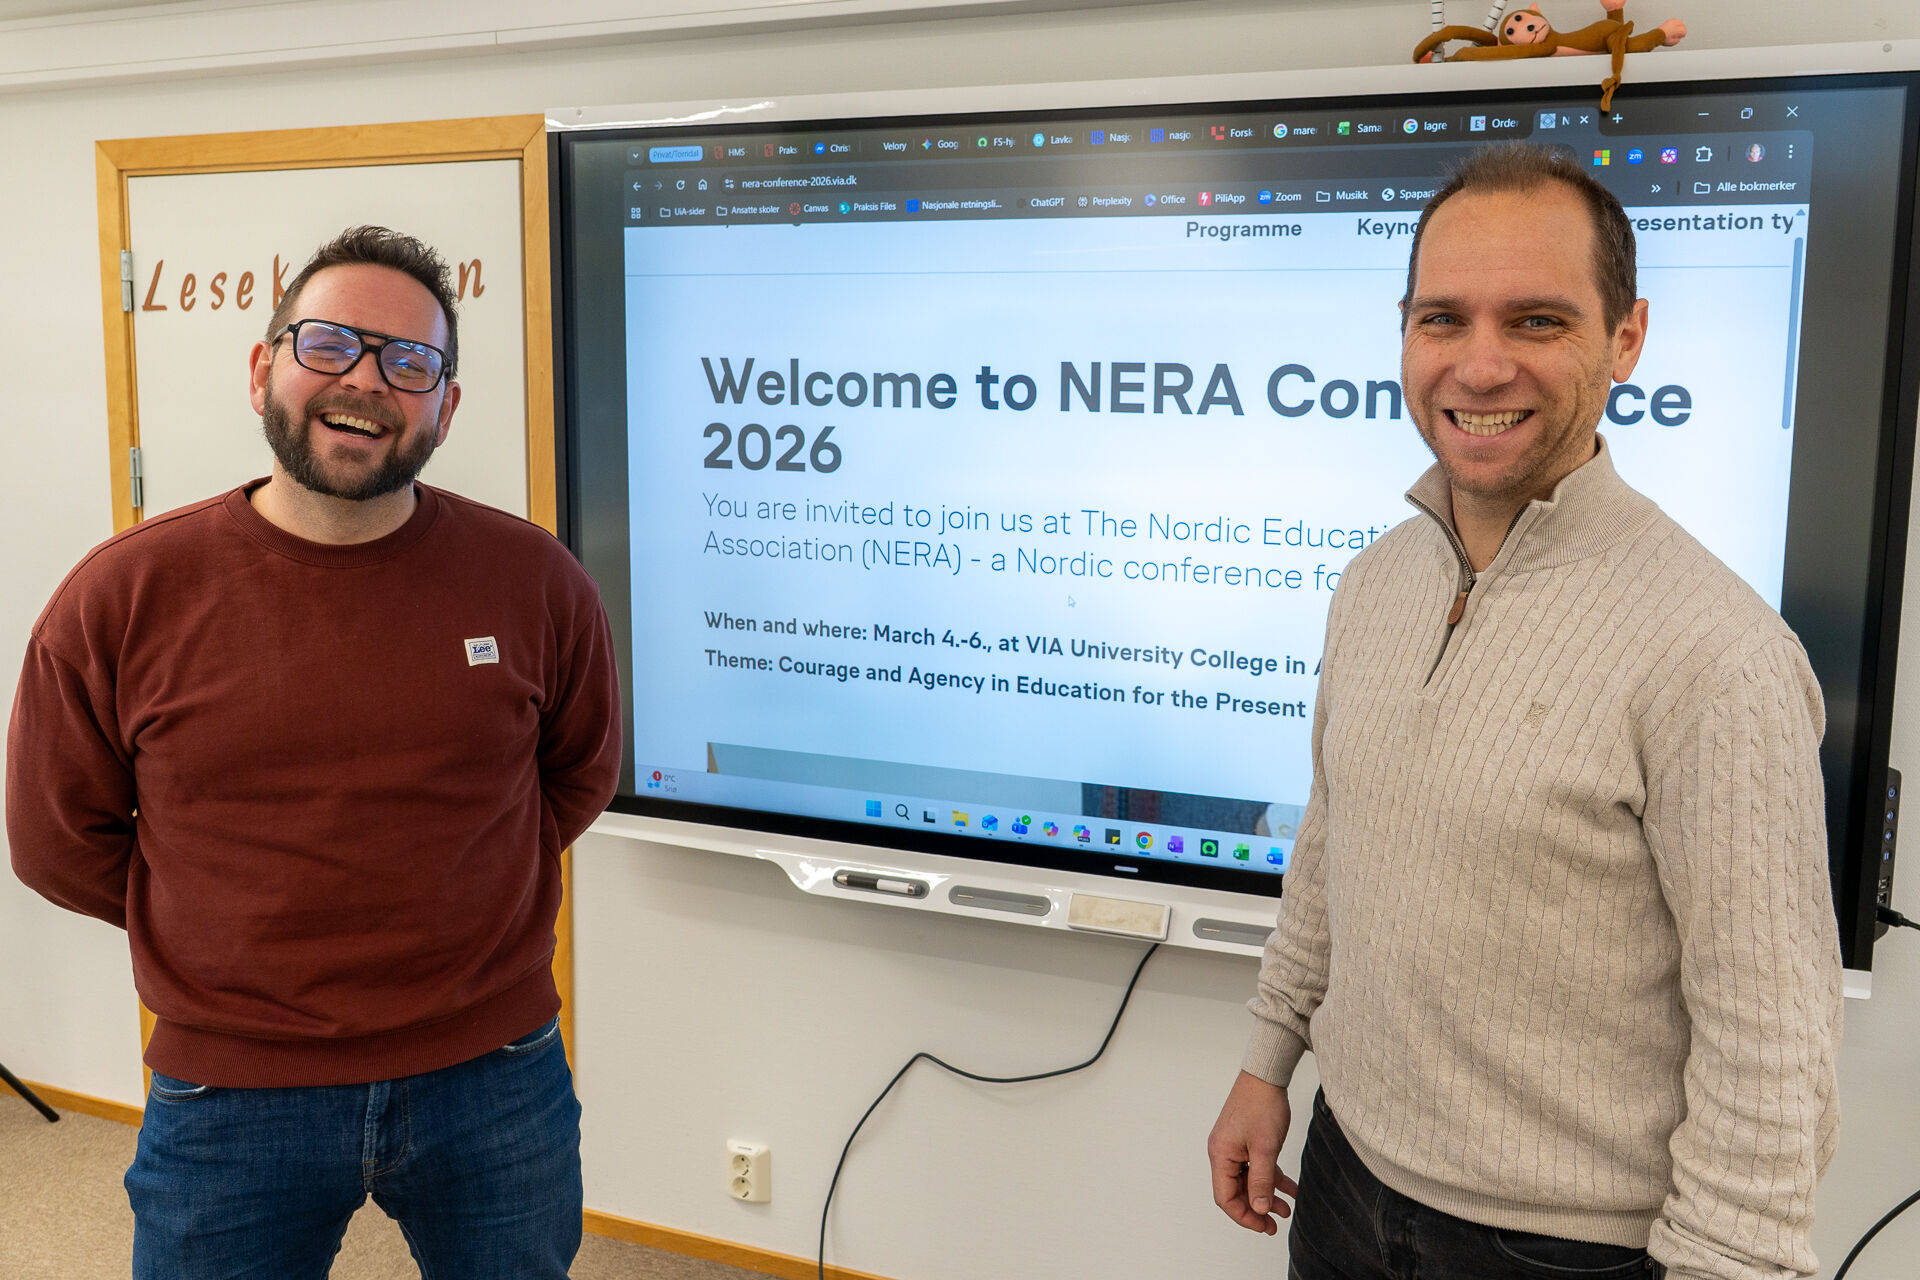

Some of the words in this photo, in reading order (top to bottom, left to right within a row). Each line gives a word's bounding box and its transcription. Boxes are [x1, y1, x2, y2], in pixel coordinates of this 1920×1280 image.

[1357, 123, 1382, 133] Sama
[1423, 121, 1448, 133] lagre
[1169, 131, 1192, 142] nasjo
[883, 142, 907, 153] Velory
[993, 137, 1016, 148] FS-hj
[728, 148, 745, 157] HMS
[742, 175, 857, 188] nera-conference-2026.via.dk
[1716, 181, 1737, 192] Alle
[1740, 180, 1797, 191] bokmerker
[1160, 194, 1186, 204] Office
[1215, 193, 1245, 204] PiliApp
[1275, 192, 1302, 202] Zoom
[1336, 190, 1368, 200] Musikk
[853, 203, 878, 212] Praksis
[880, 202, 896, 211] Files
[922, 201, 959, 212] Nasjonale
[1030, 198, 1064, 208] ChatGPT
[1092, 196, 1132, 208] Perplexity
[674, 208, 706, 216] UiA-sider
[731, 206, 757, 214] Ansatte
[758, 205, 780, 214] skoler
[803, 204, 829, 213] Canvas
[1629, 212, 1763, 231] resentation
[1186, 221, 1302, 242] Programme
[700, 357, 957, 410] Welcome
[975, 366, 1037, 411] to
[1060, 361, 1245, 416] NERA
[703, 422, 842, 473] 2026
[702, 492, 747, 518] You
[757, 502, 797, 521] are
[806, 498, 894, 525] invited
[904, 504, 931, 528] to
[938, 504, 989, 535] join
[1001, 512, 1033, 533] us
[1043, 512, 1071, 536] at
[1081, 509, 1137, 538] The
[1149, 513, 1250, 544] Nordic
[703, 530, 852, 563] Association
[862, 539, 961, 576] (NERA)
[991, 553, 1006, 572] a
[1017, 547, 1113, 578] Nordic
[1124, 557, 1302, 589] conference
[472, 645, 491, 653] Lee
[704, 611, 757, 631] When
[763, 618, 797, 635] and
[803, 620, 867, 640] where:
[874, 624, 935, 646] March
[942, 630, 992, 653] 4.-6.,
[999, 637, 1019, 653] at
[1026, 635, 1064, 656] VIA
[1071, 638, 1183, 670] University
[1190, 648, 1278, 677] College
[1286, 655, 1305, 674] in
[705, 649, 773, 672] Theme:
[778, 656, 860, 682] Courage
[866, 666, 902, 683] and
[908, 667, 985, 694] Agency
[992, 674, 1009, 693] in
[1017, 675, 1126, 703] Education
[1132, 686, 1164, 706] for
[1171, 689, 1208, 709] the
[1216, 692, 1306, 718] Present
